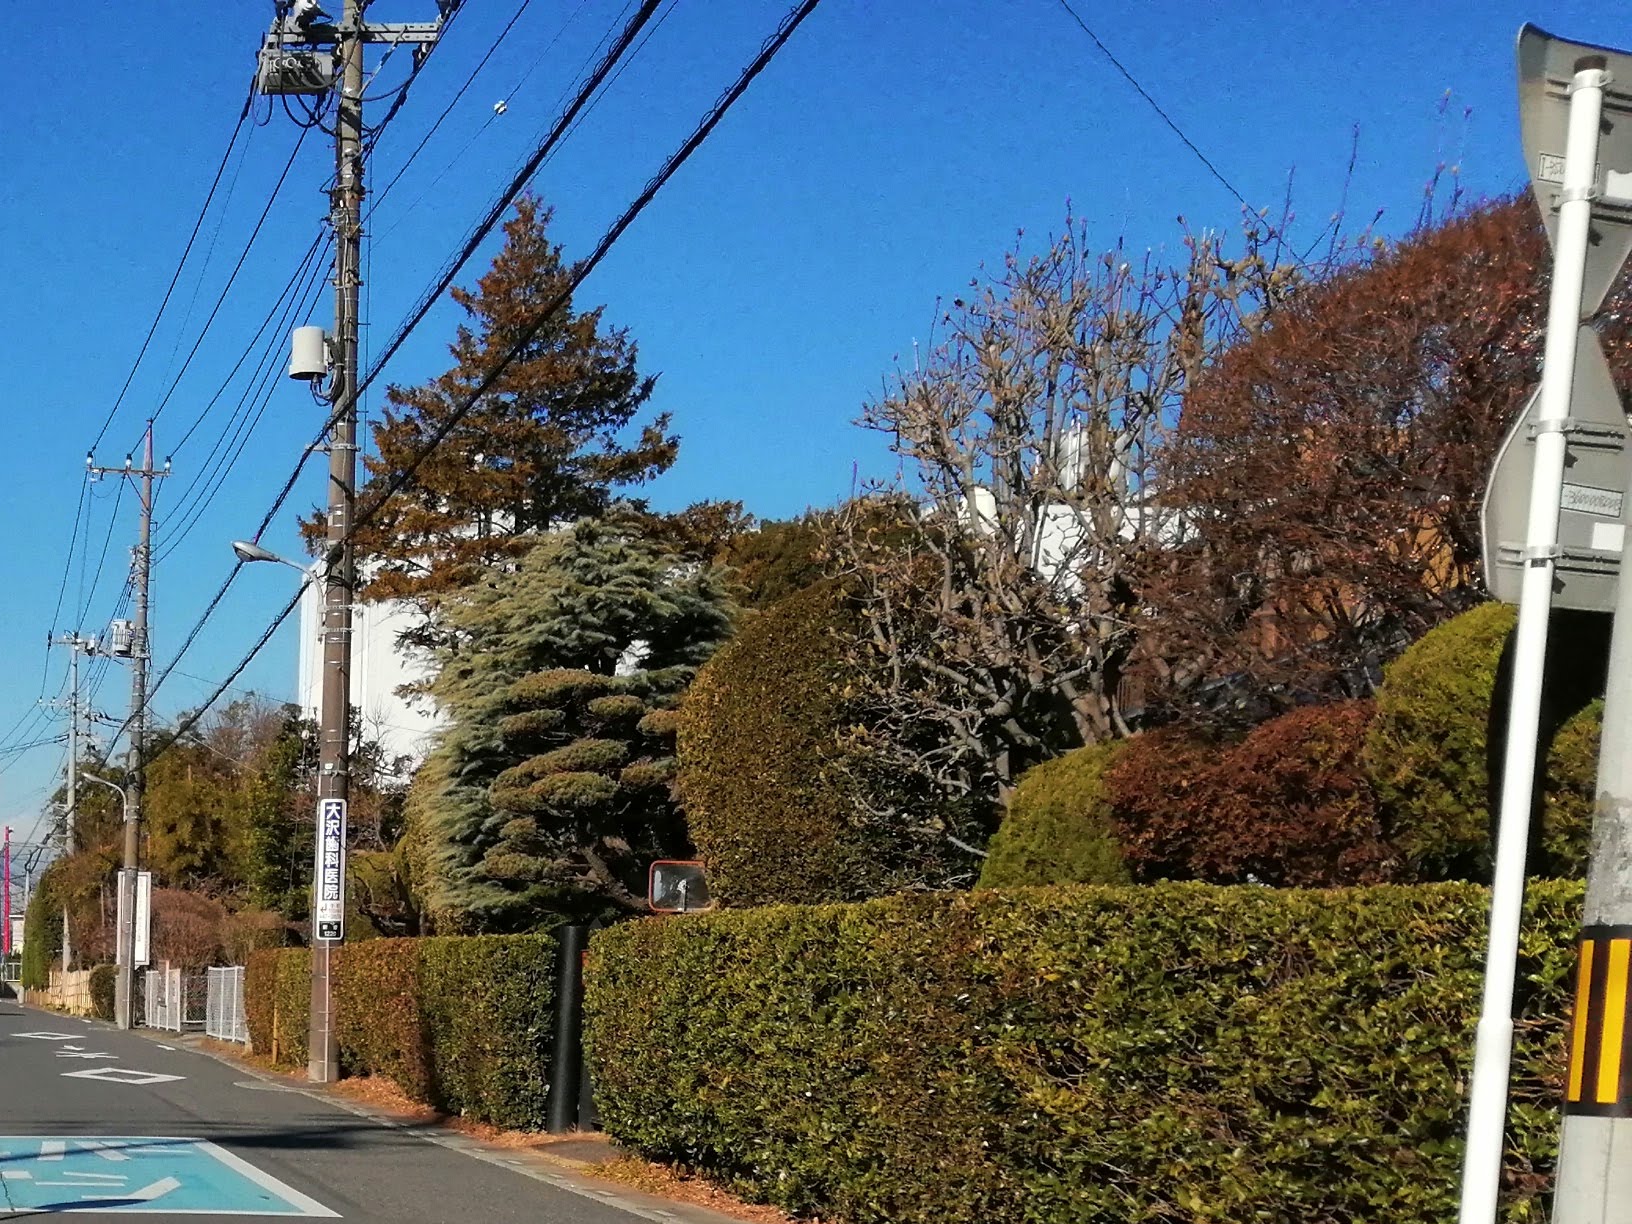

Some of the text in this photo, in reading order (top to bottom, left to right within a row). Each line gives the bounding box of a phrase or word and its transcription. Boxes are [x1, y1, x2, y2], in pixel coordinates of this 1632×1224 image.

[324, 803, 341, 900] 大沢歯科医院
